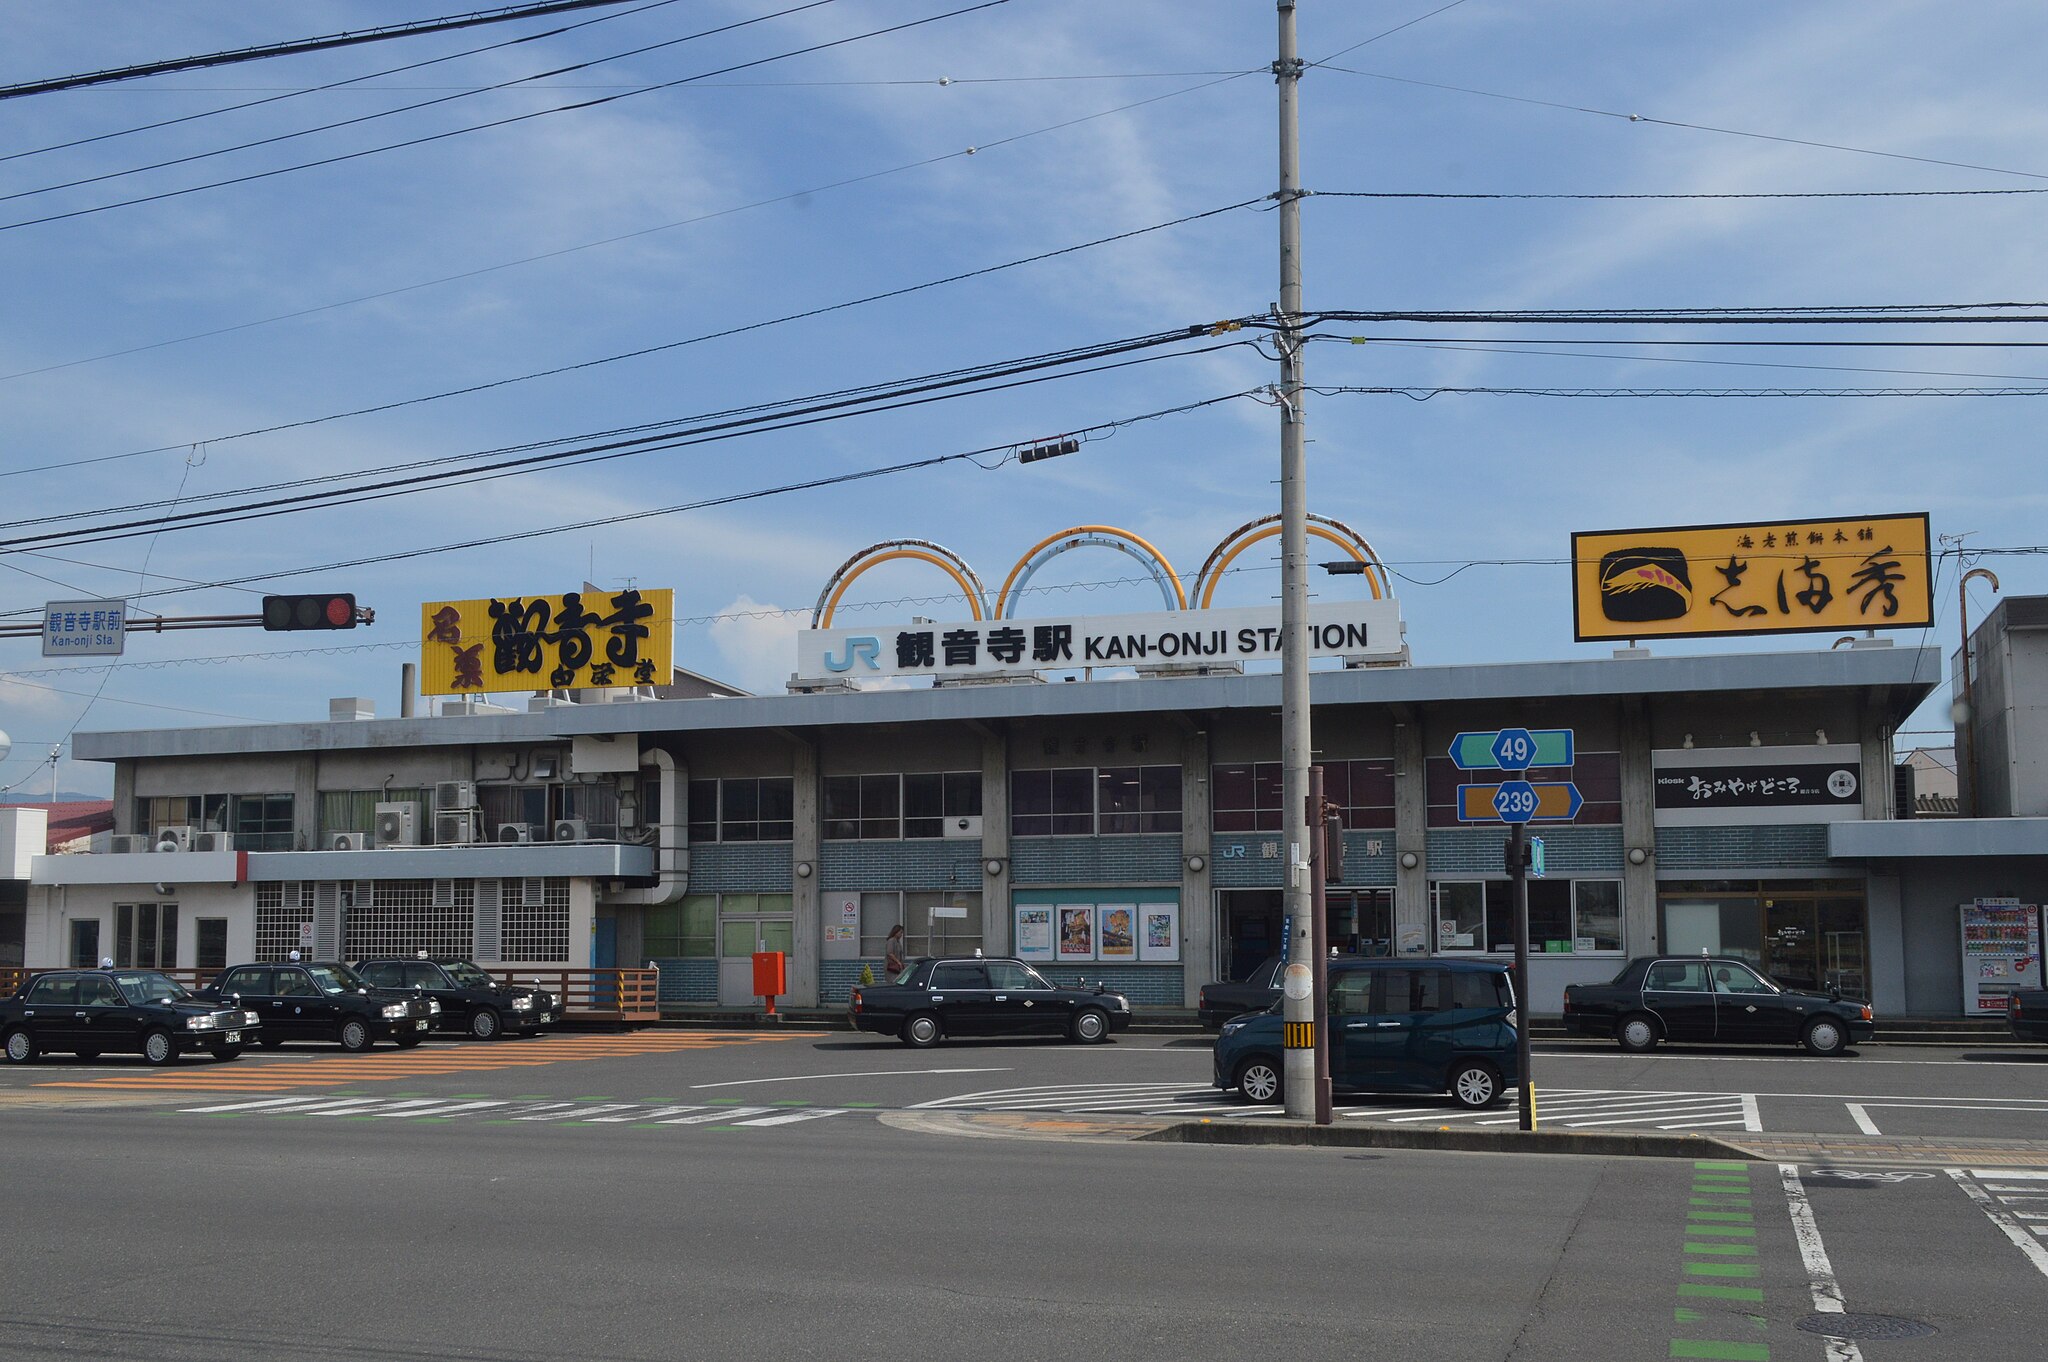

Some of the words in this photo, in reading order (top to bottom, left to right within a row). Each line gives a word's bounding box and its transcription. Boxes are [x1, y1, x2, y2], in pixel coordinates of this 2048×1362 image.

[49, 610, 120, 632] 観音寺駅前
[51, 635, 93, 648] Kan-onji
[96, 634, 115, 645] Sta.
[824, 636, 880, 672] JR
[896, 624, 1074, 669] 観音寺駅
[1085, 630, 1227, 660] KAN-ONJI
[1500, 738, 1528, 761] 49
[1687, 776, 1800, 800] おみやげどころ
[1499, 791, 1534, 812] 239
[1223, 845, 1246, 858] JR
